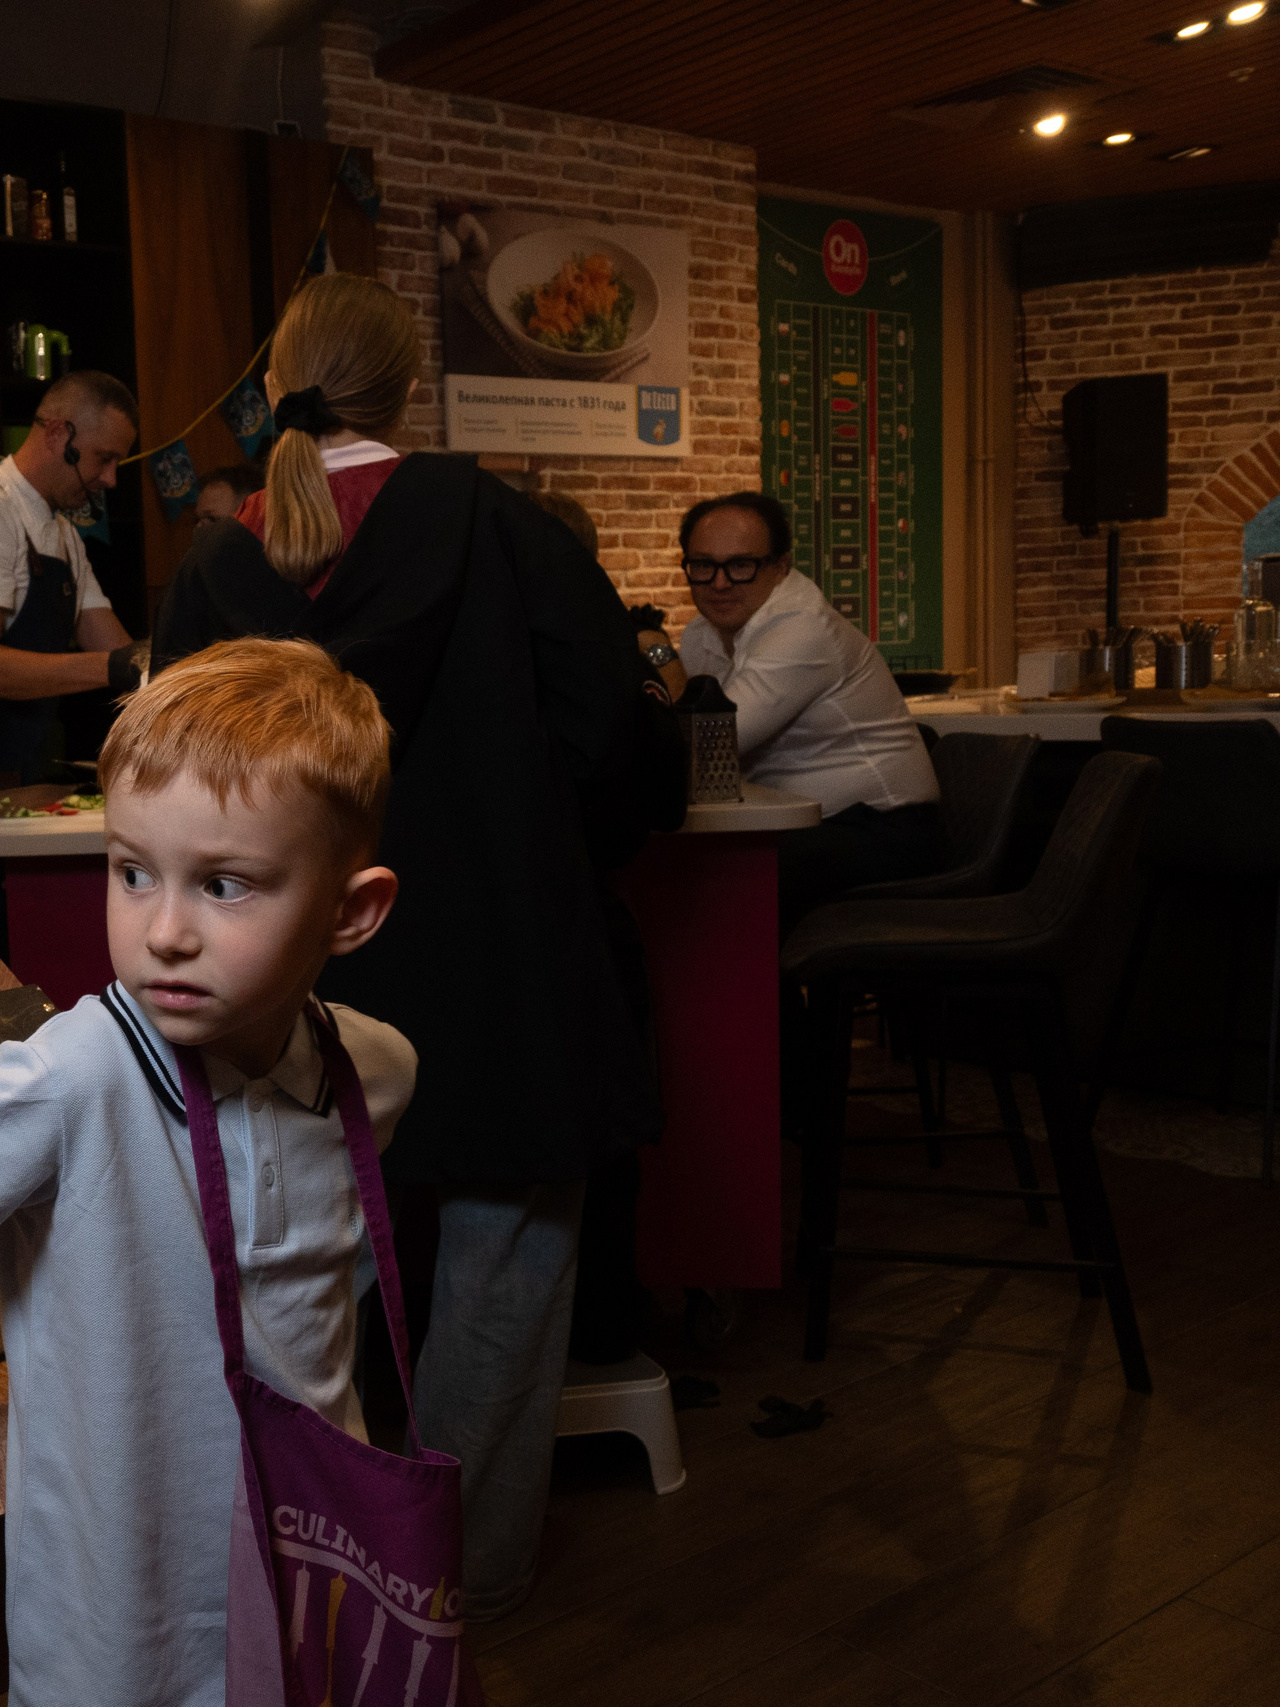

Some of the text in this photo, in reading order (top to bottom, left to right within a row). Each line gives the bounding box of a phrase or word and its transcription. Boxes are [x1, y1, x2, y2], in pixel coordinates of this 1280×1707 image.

[828, 233, 861, 265] On
[457, 389, 536, 406] Великолепная
[538, 396, 567, 408] паста
[578, 396, 601, 409] 1831
[603, 399, 627, 412] года
